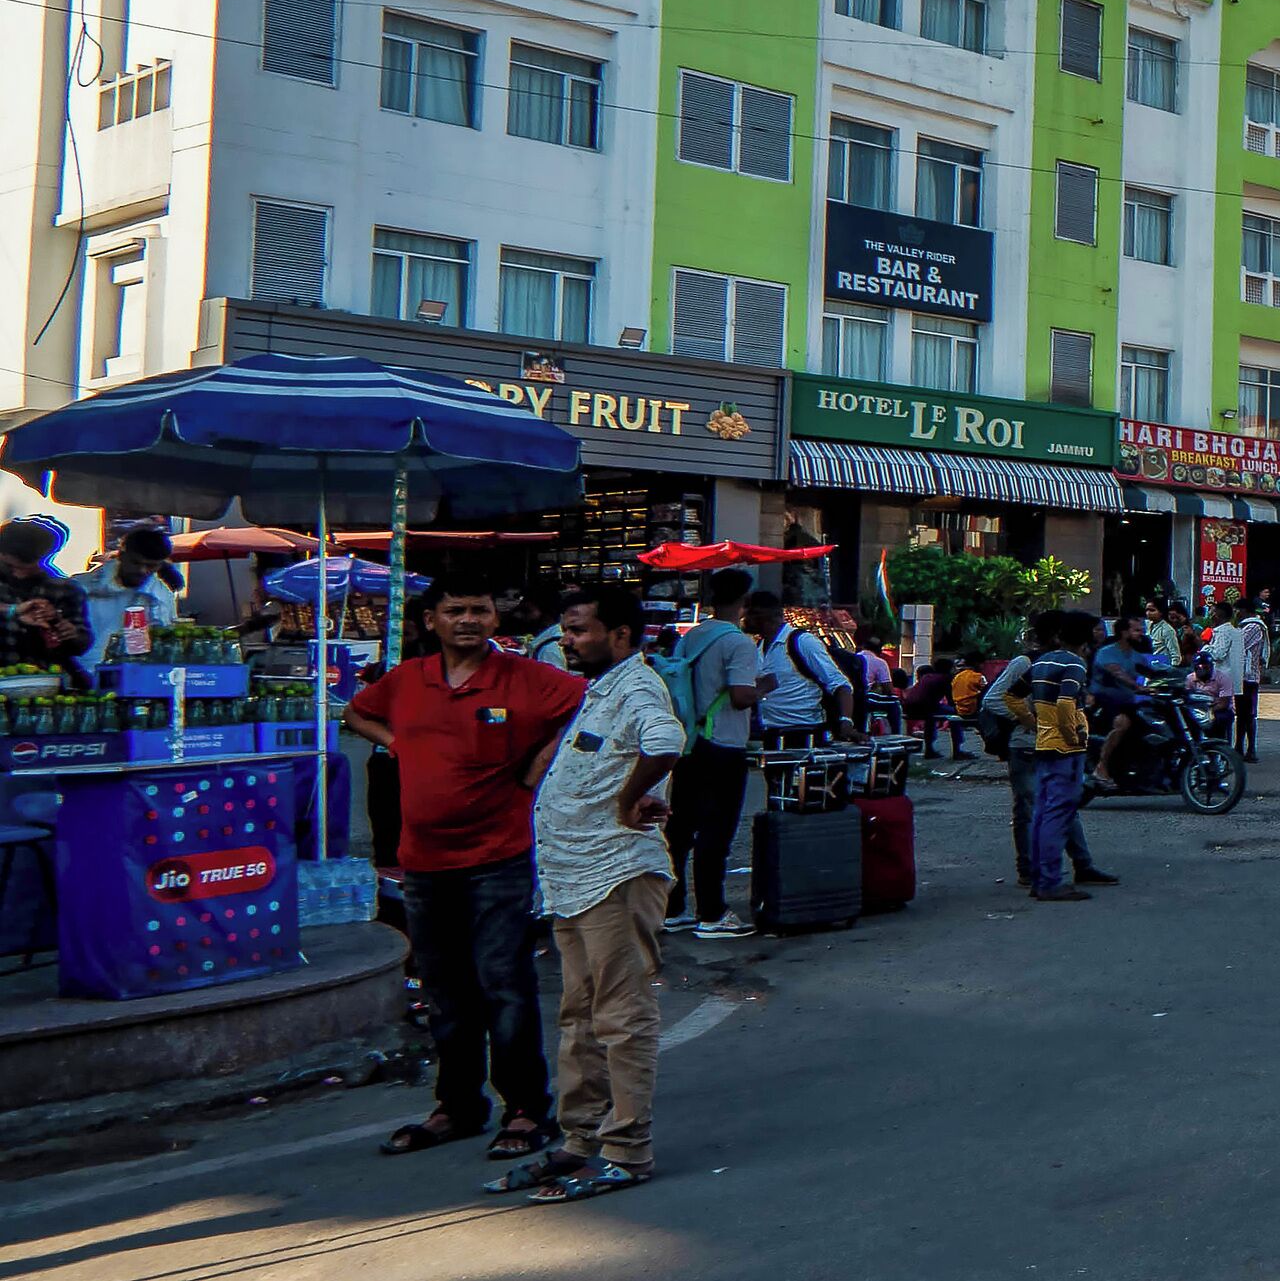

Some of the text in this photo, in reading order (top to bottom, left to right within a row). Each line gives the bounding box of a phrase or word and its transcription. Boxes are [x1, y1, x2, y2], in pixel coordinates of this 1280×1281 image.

[864, 239, 956, 265] THE VALLEY RIDER
[876, 256, 942, 284] BAR &
[837, 271, 979, 310] RESTAURANT
[569, 390, 690, 435] FRUIT
[817, 389, 909, 418] HOTEL
[1120, 420, 1183, 449] HARI
[1047, 442, 1094, 458] JAMMU
[1203, 560, 1243, 578] HARI
[40, 742, 108, 758] PEPSI
[154, 861, 267, 890] Jio TRUE 5G
